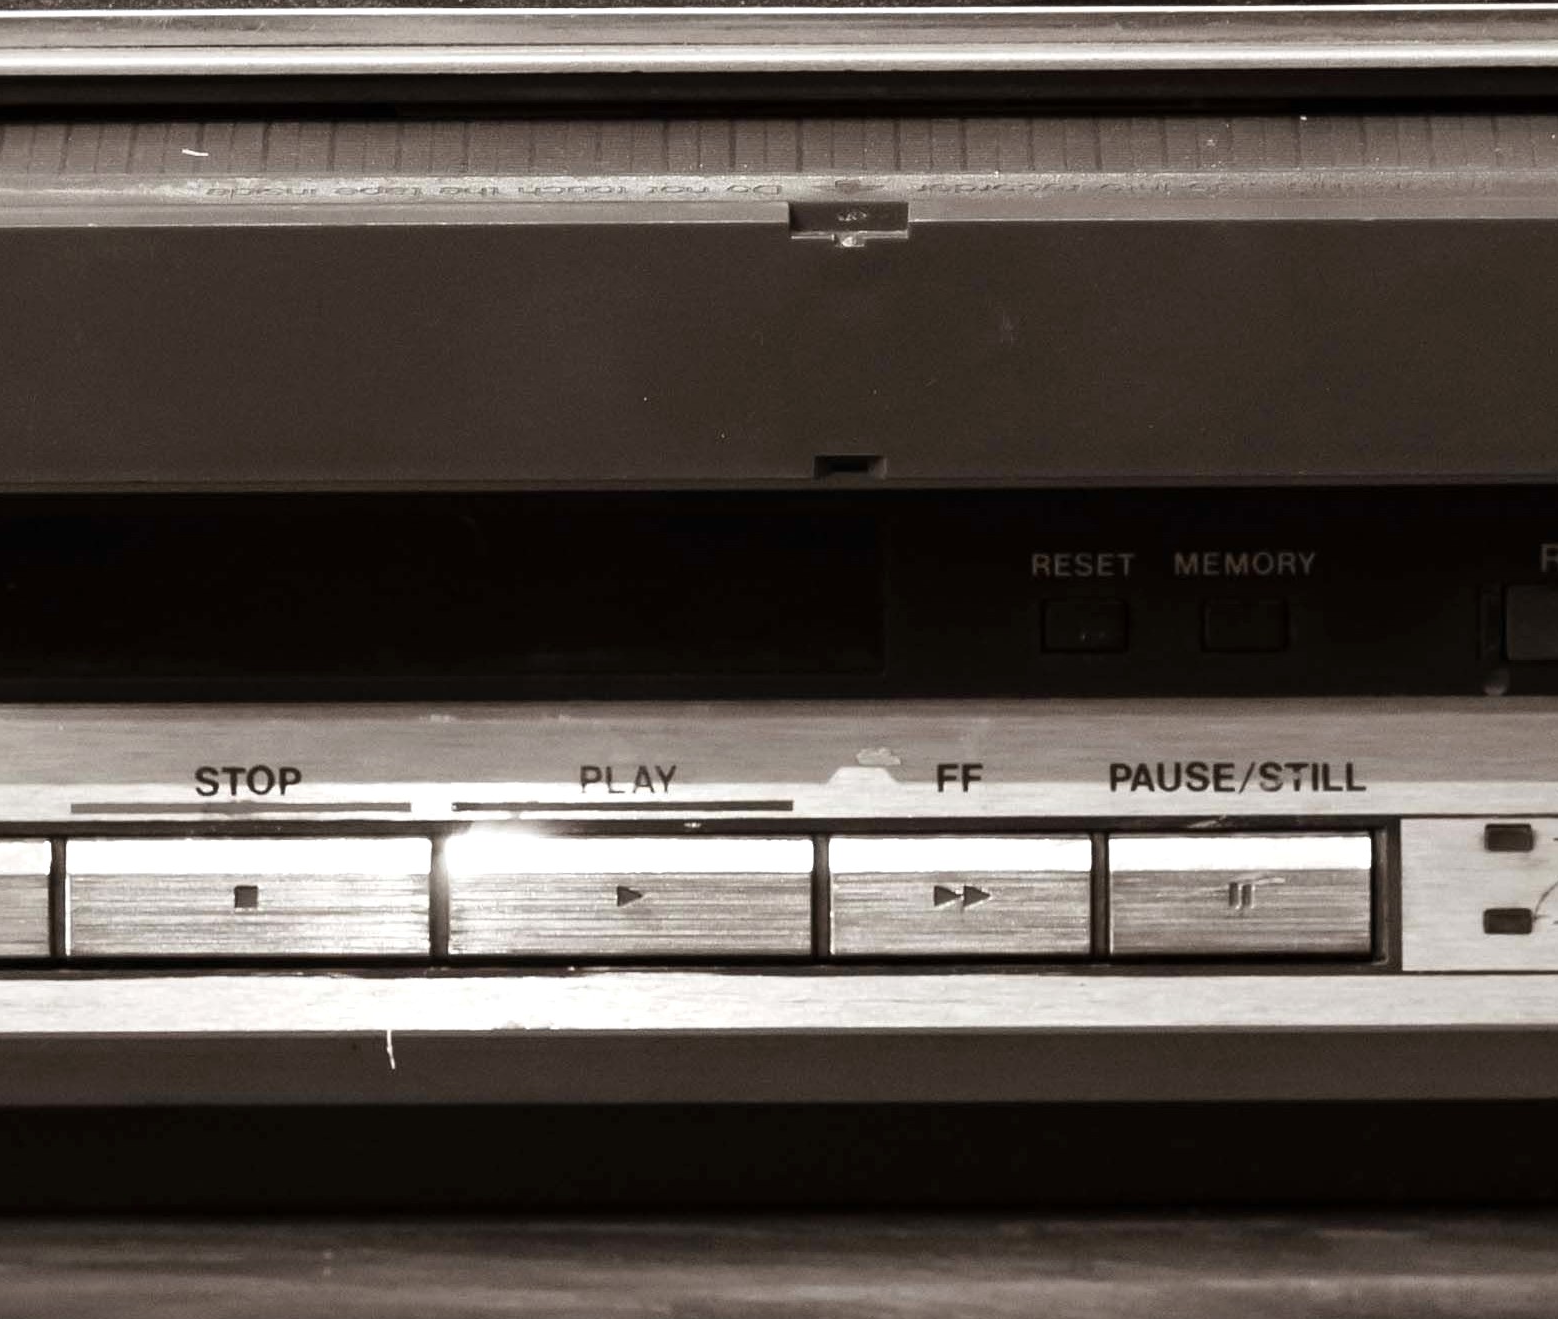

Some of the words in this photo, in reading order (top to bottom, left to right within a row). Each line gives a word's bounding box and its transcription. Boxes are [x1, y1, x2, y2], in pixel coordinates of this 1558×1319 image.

[1031, 553, 1135, 577] RESET
[1175, 552, 1316, 576] MEMORY
[195, 767, 302, 798] STOP
[579, 765, 677, 795] PLAY
[936, 764, 984, 793] FF
[1109, 762, 1367, 793] PAUSE/STILL
